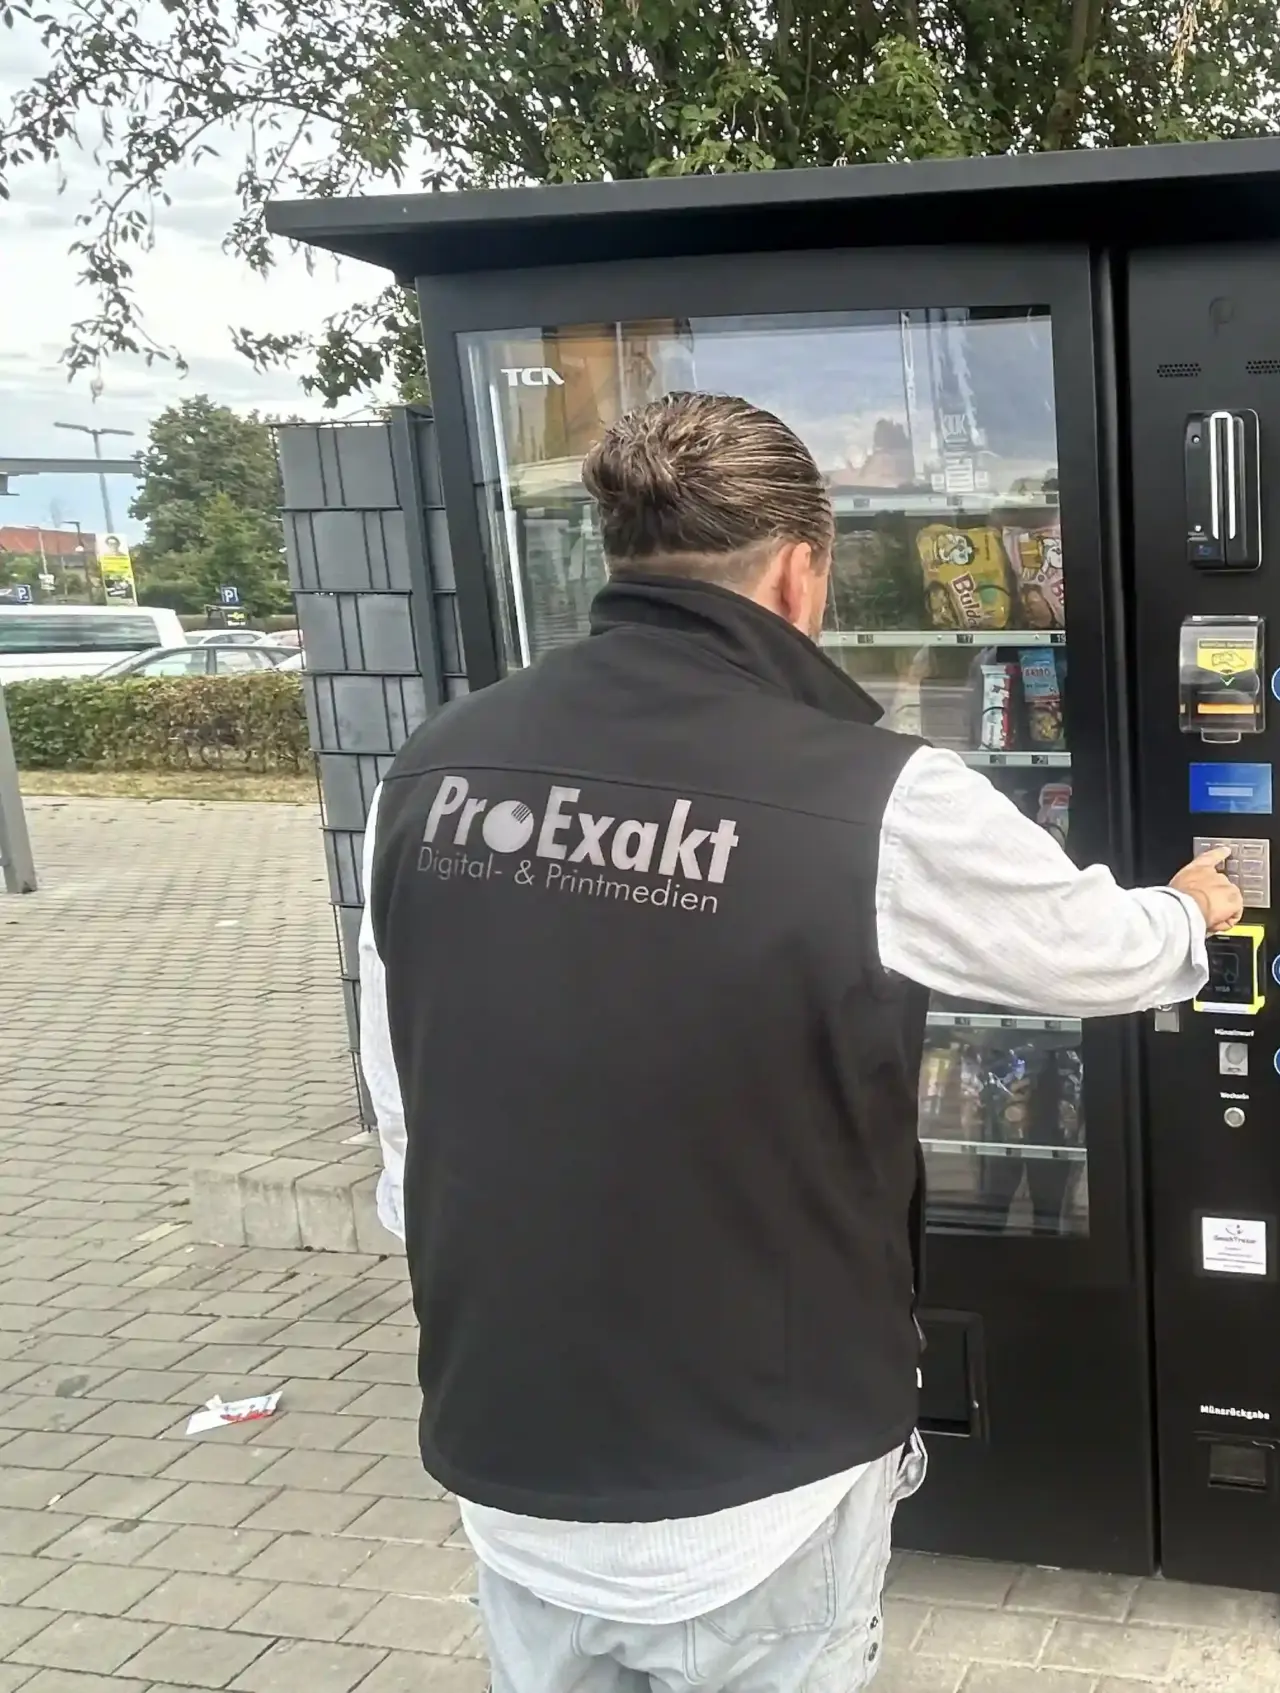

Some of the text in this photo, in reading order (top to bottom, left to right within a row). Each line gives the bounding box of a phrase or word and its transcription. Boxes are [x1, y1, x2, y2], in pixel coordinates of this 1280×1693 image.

[500, 367, 564, 386] TCN
[224, 588, 233, 602] P
[417, 846, 718, 913] Digital- & Printmedien
